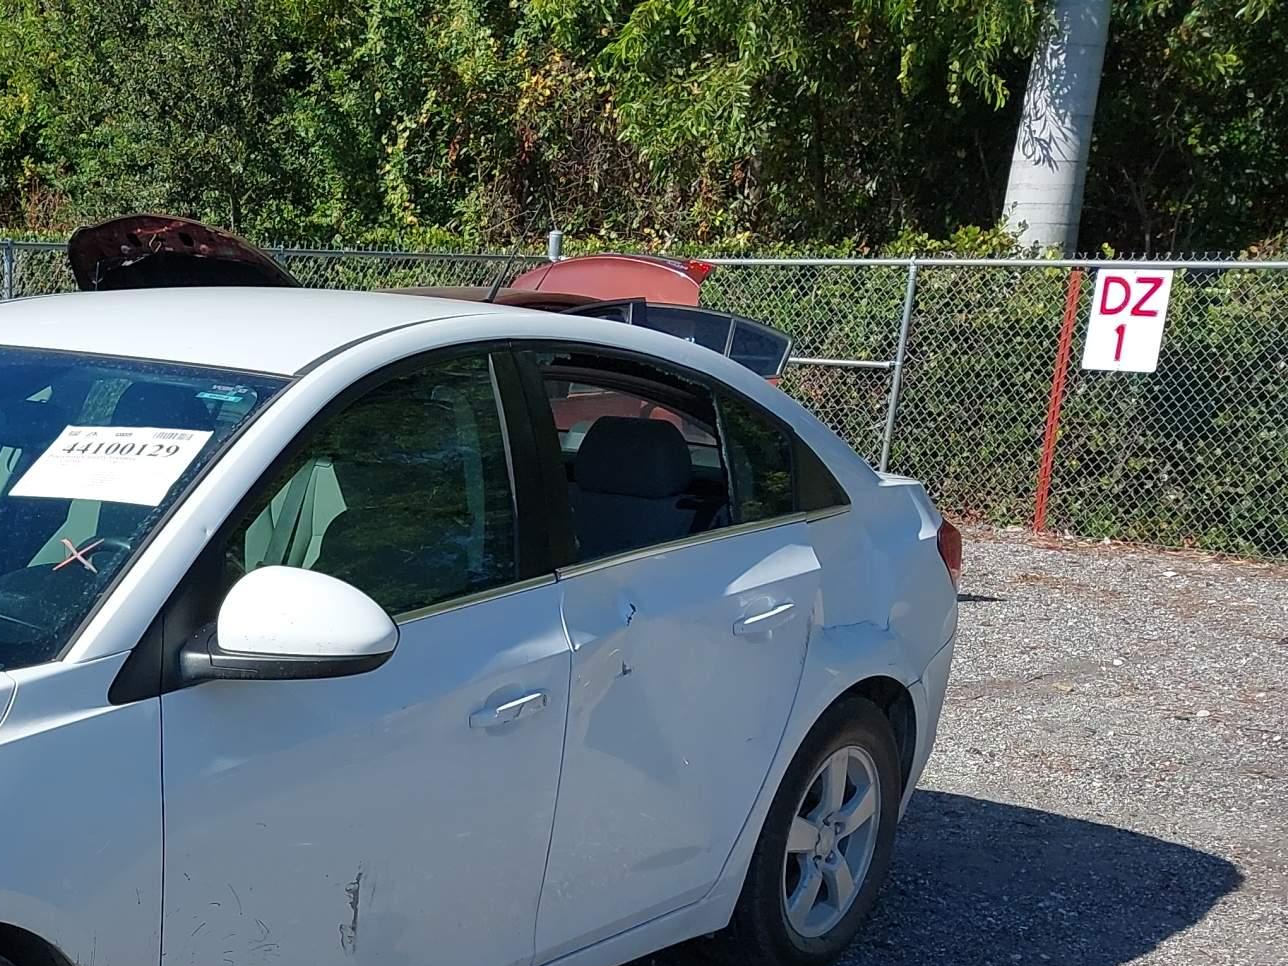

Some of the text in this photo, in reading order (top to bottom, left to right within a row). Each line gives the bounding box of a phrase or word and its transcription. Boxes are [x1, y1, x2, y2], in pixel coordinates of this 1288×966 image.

[1099, 276, 1164, 317] DZ
[1114, 323, 1126, 362] 1
[62, 442, 181, 458] 44100129
